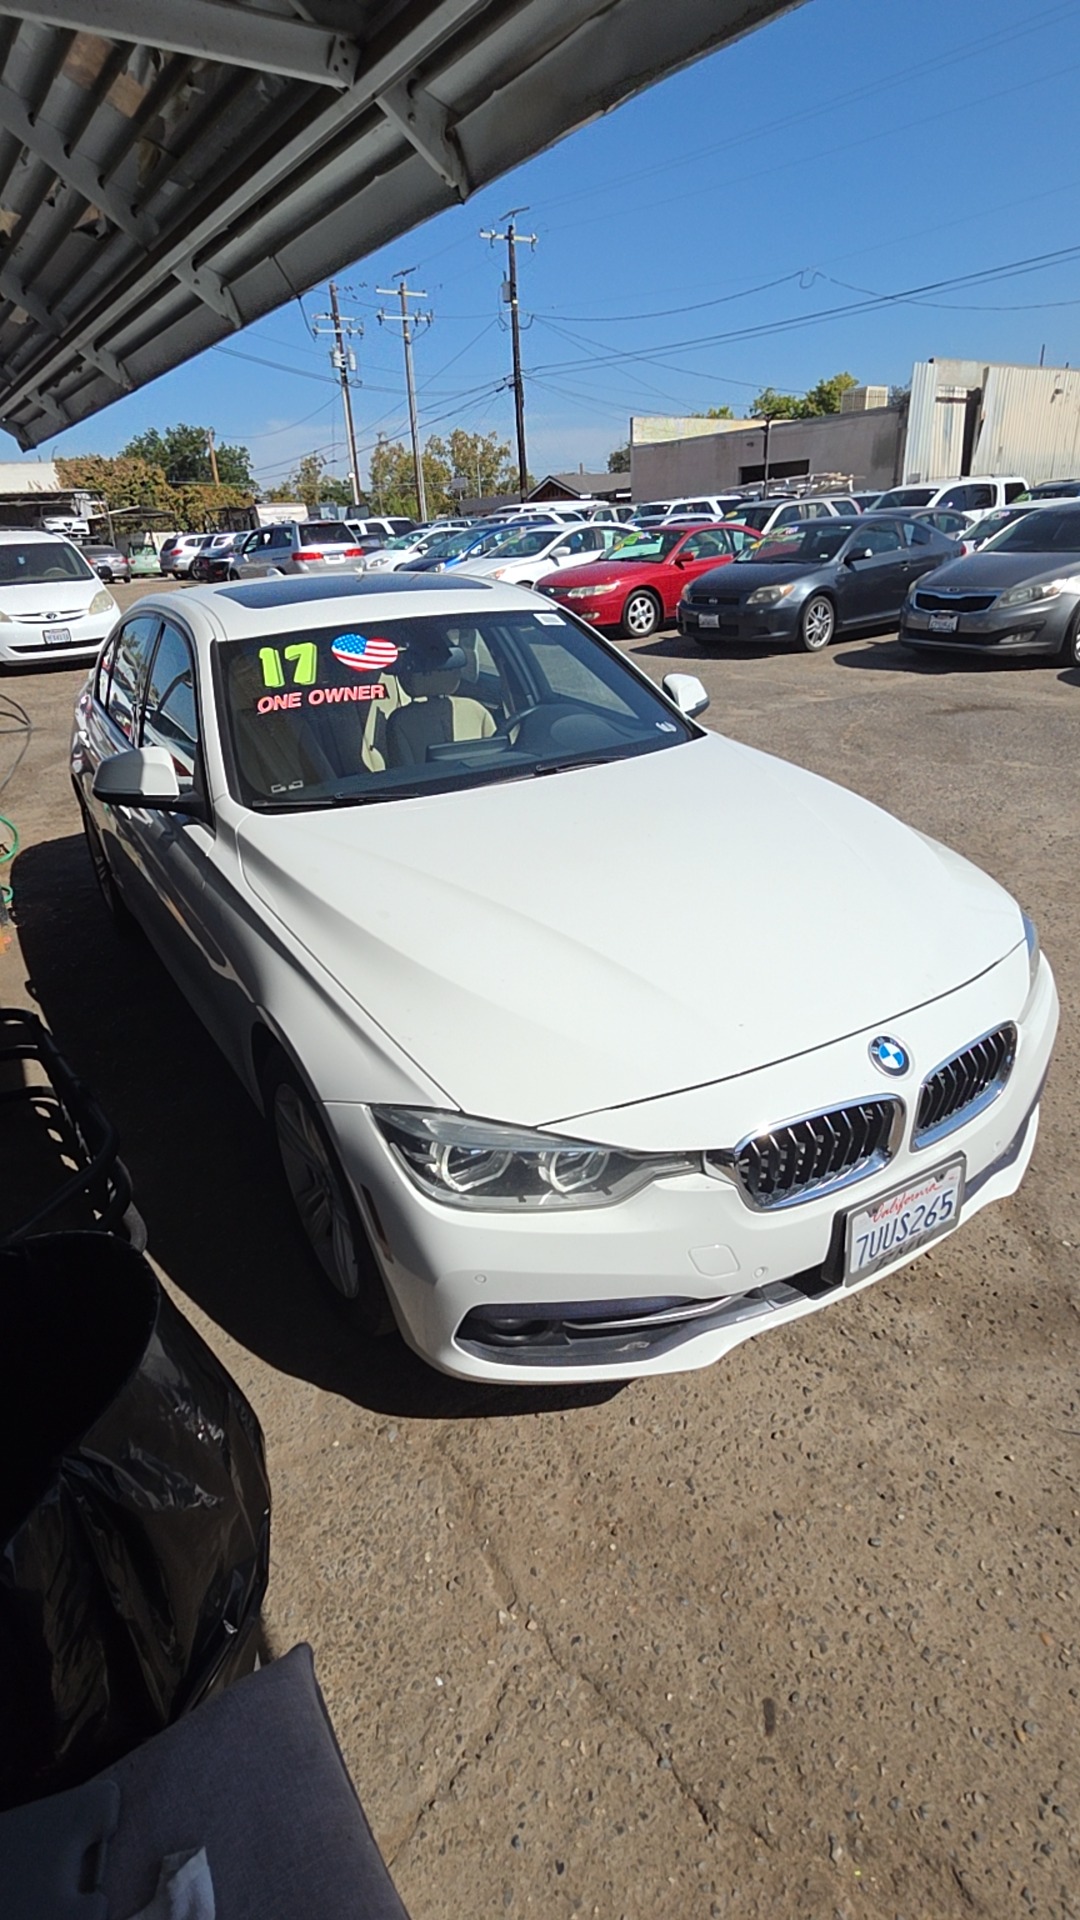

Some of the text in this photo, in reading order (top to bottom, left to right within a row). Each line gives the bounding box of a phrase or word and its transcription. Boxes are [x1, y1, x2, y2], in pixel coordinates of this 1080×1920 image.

[259, 642, 317, 688] 17
[257, 684, 385, 715] ONE OWNER
[871, 1182, 943, 1223] California
[856, 1189, 955, 1267] 7UUS265
